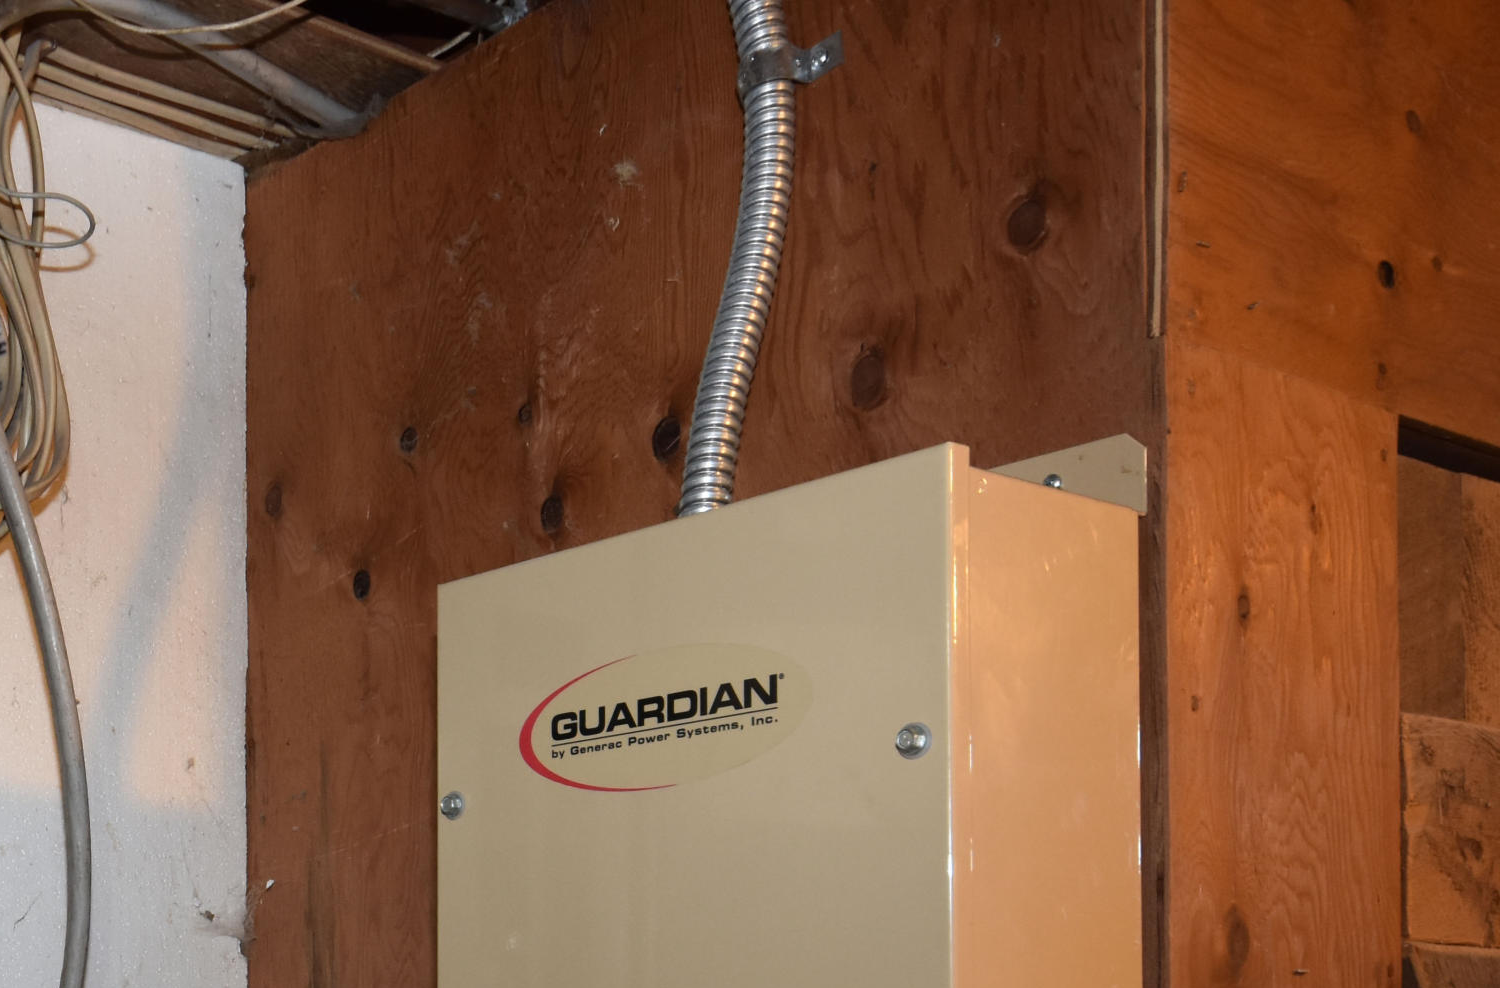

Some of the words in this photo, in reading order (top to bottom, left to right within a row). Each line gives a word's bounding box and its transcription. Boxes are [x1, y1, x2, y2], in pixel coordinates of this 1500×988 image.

[551, 673, 779, 742] GUARDIAN
[551, 749, 566, 759] by
[570, 739, 623, 756] Generac
[627, 731, 671, 747] Power
[676, 720, 745, 739] Systems,
[751, 714, 779, 727] Inc.
